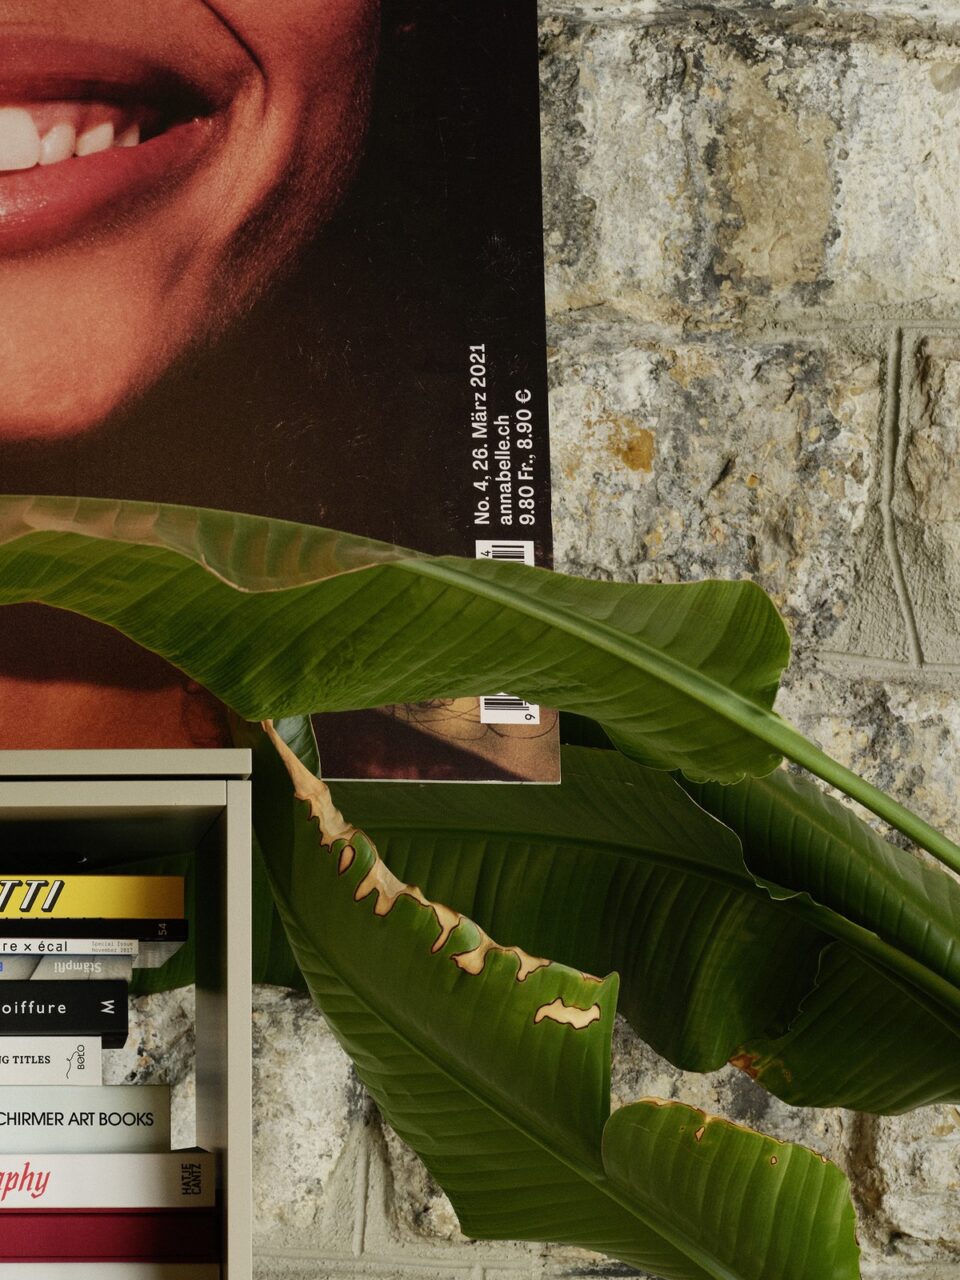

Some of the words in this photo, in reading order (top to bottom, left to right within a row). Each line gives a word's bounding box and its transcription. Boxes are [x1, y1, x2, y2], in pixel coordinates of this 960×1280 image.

[470, 343, 486, 387] 2021
[515, 389, 532, 404] €
[471, 392, 487, 439] März
[516, 409, 533, 449] 8.90
[472, 443, 489, 471] 26.
[493, 415, 513, 526] annabelle.ch
[518, 454, 536, 480] Fr.,
[473, 475, 491, 492] 4,
[474, 496, 490, 525] No.
[518, 485, 535, 526] 9.80
[38, 940, 68, 952] écal
[54, 960, 102, 973] Stämpfli
[13, 1055, 51, 1065] TITLES
[68, 1111, 95, 1126] ART
[99, 1111, 154, 1127] BOOKS
